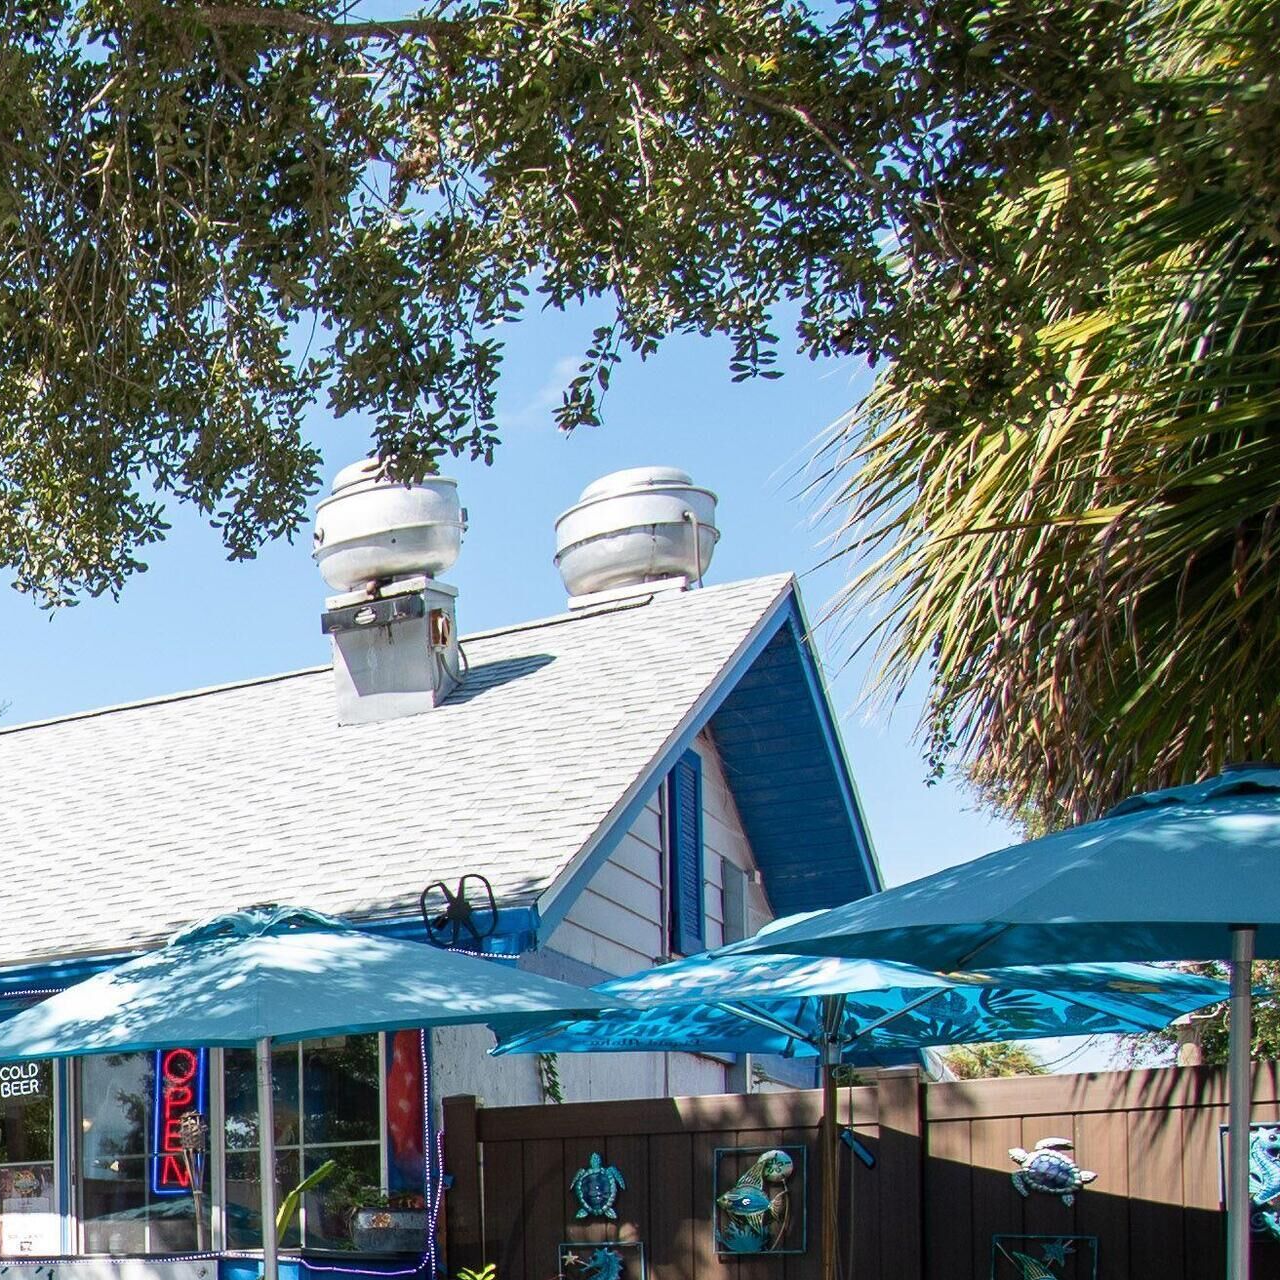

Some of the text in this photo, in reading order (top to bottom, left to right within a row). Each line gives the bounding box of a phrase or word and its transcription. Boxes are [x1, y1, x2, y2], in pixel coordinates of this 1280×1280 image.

[0, 1062, 39, 1080] COLD
[0, 1079, 40, 1099] BEER
[162, 1048, 197, 1187] OPEN
